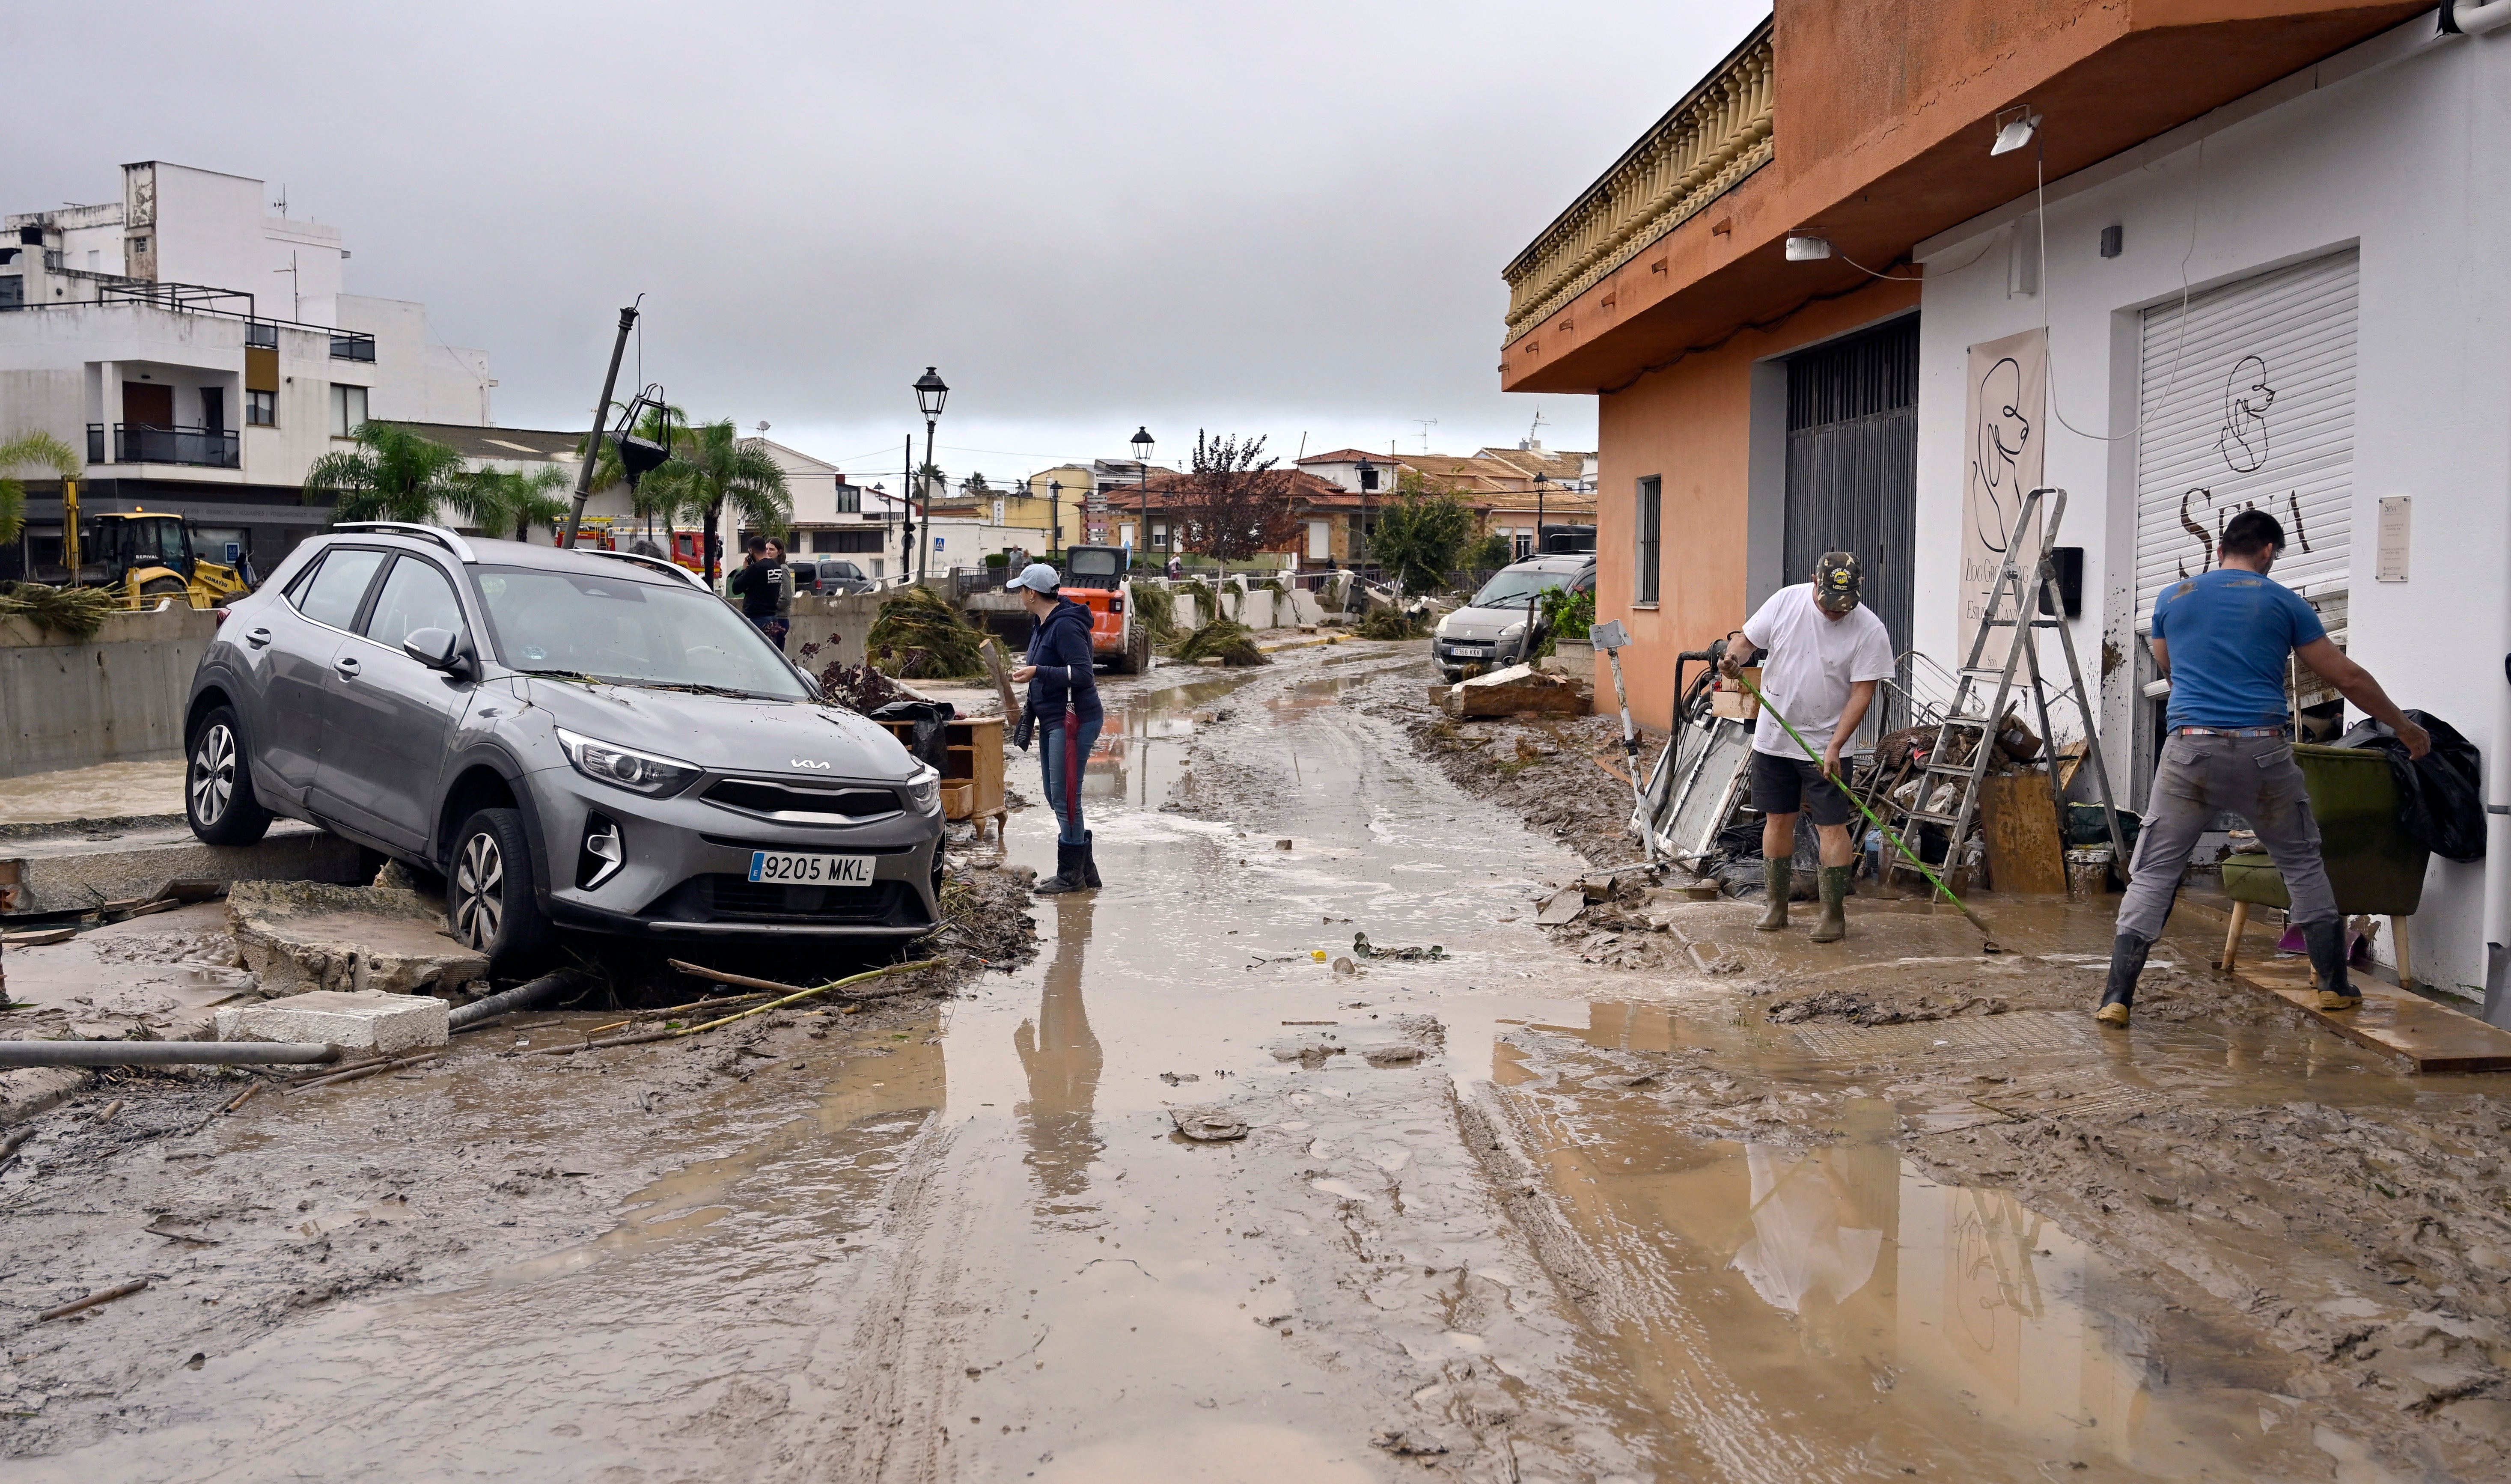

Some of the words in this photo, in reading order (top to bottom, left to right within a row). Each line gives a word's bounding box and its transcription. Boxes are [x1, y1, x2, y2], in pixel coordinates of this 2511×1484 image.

[204, 575, 228, 588] KOMATSU
[791, 759, 830, 770] KIA
[765, 856, 821, 880] 9205
[828, 859, 867, 881] MKL
